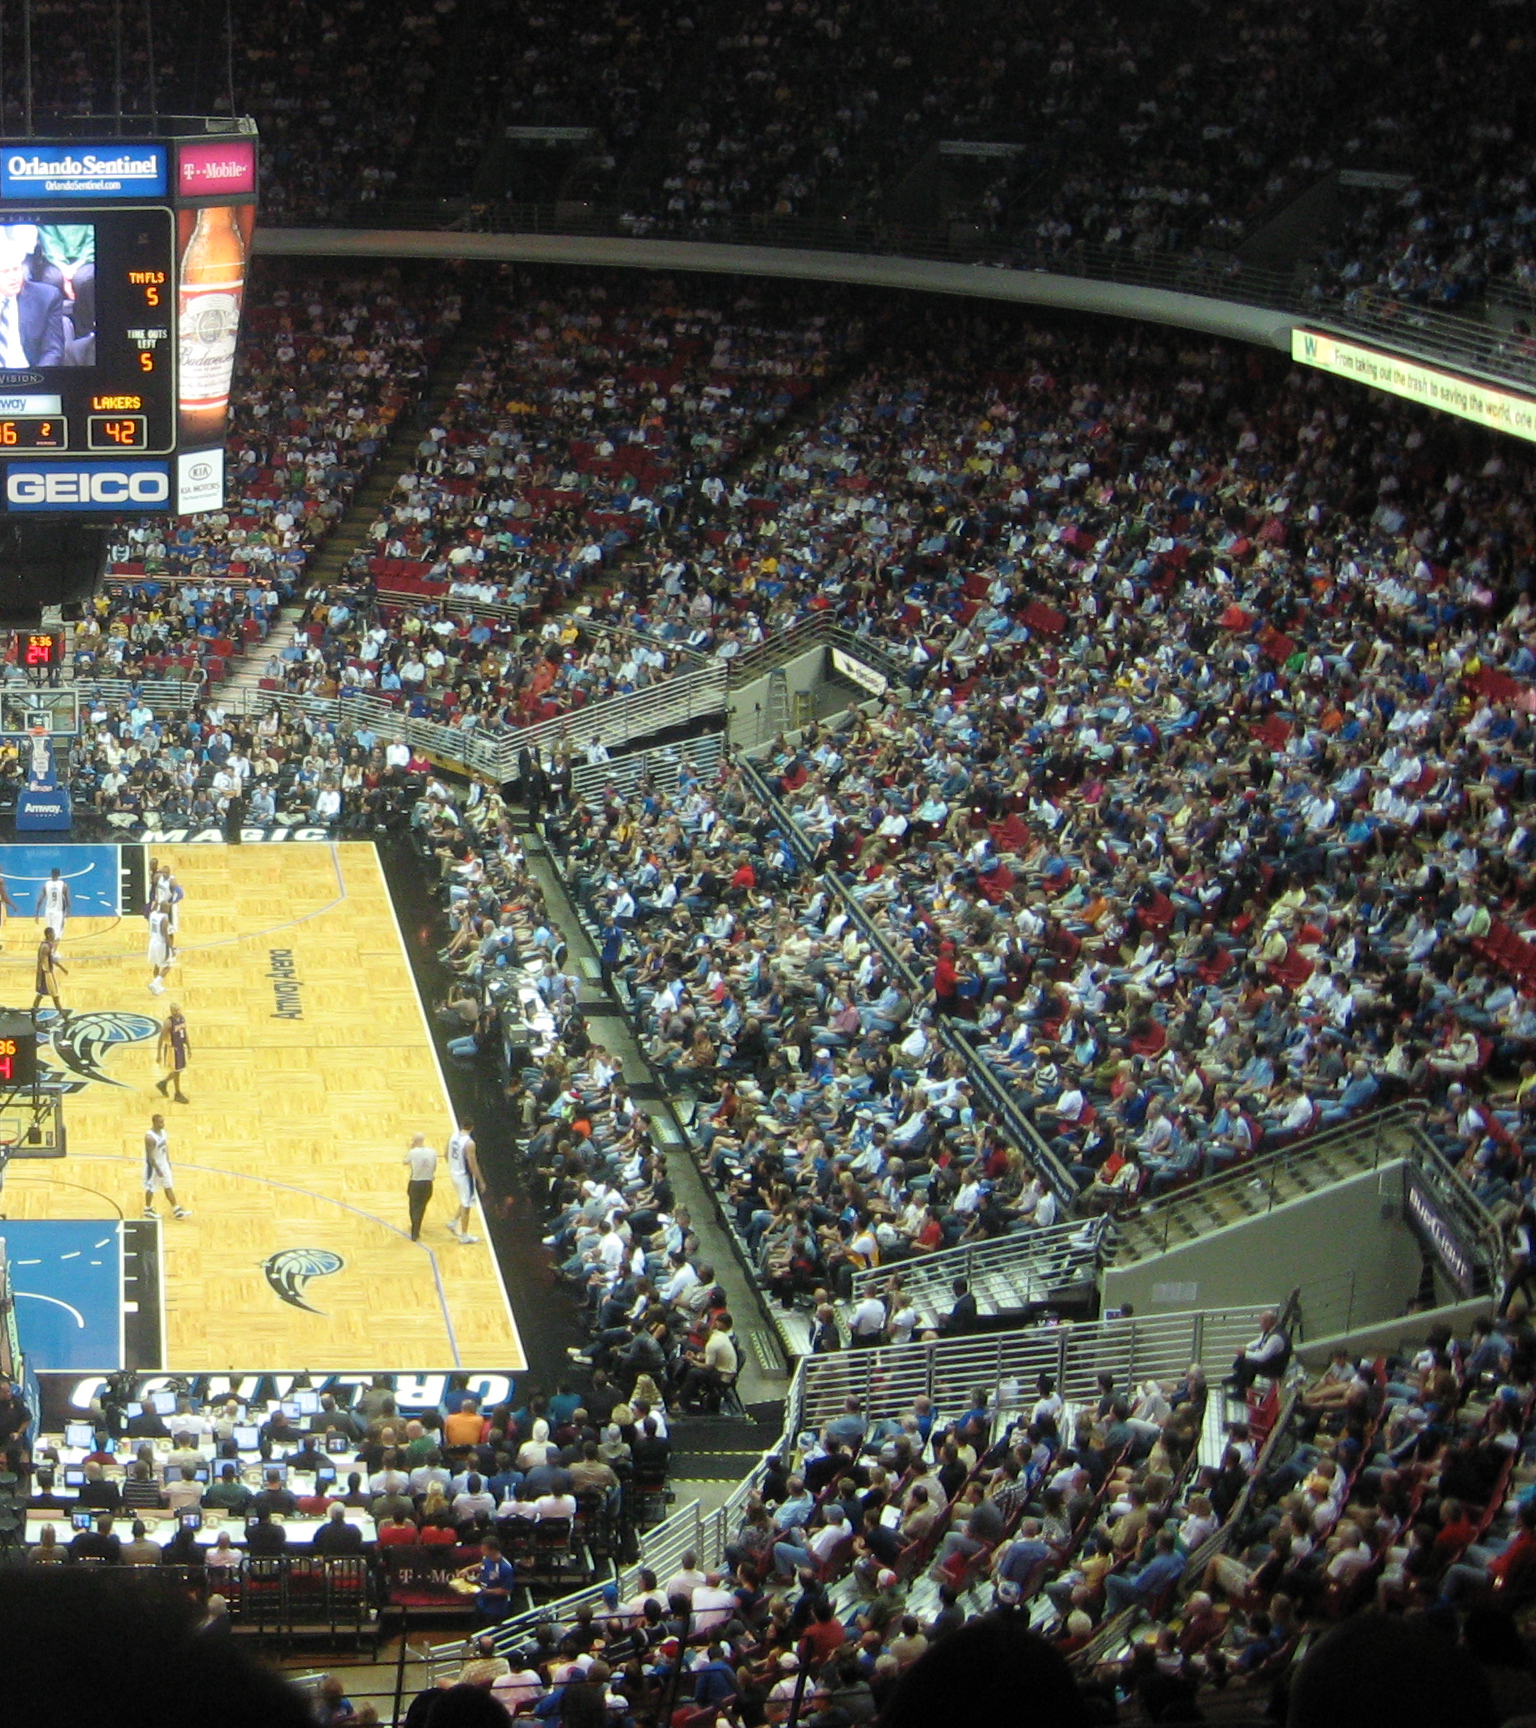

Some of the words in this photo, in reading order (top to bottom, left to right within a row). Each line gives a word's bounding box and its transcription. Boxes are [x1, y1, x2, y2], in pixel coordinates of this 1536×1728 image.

[8, 156, 81, 175] Orlando
[83, 155, 158, 175] Sentinel
[45, 180, 121, 191] OrlandoSentinel.com
[146, 288, 159, 306] 5
[140, 352, 153, 371] 5
[93, 397, 141, 410] LAKERS
[41, 423, 52, 437] 2
[105, 421, 136, 445] 42
[7, 472, 169, 503] GEICO
[30, 636, 53, 647] 5:36
[27, 647, 51, 663] 24
[265, 949, 296, 979] Arena
[270, 979, 304, 1020] Amway
